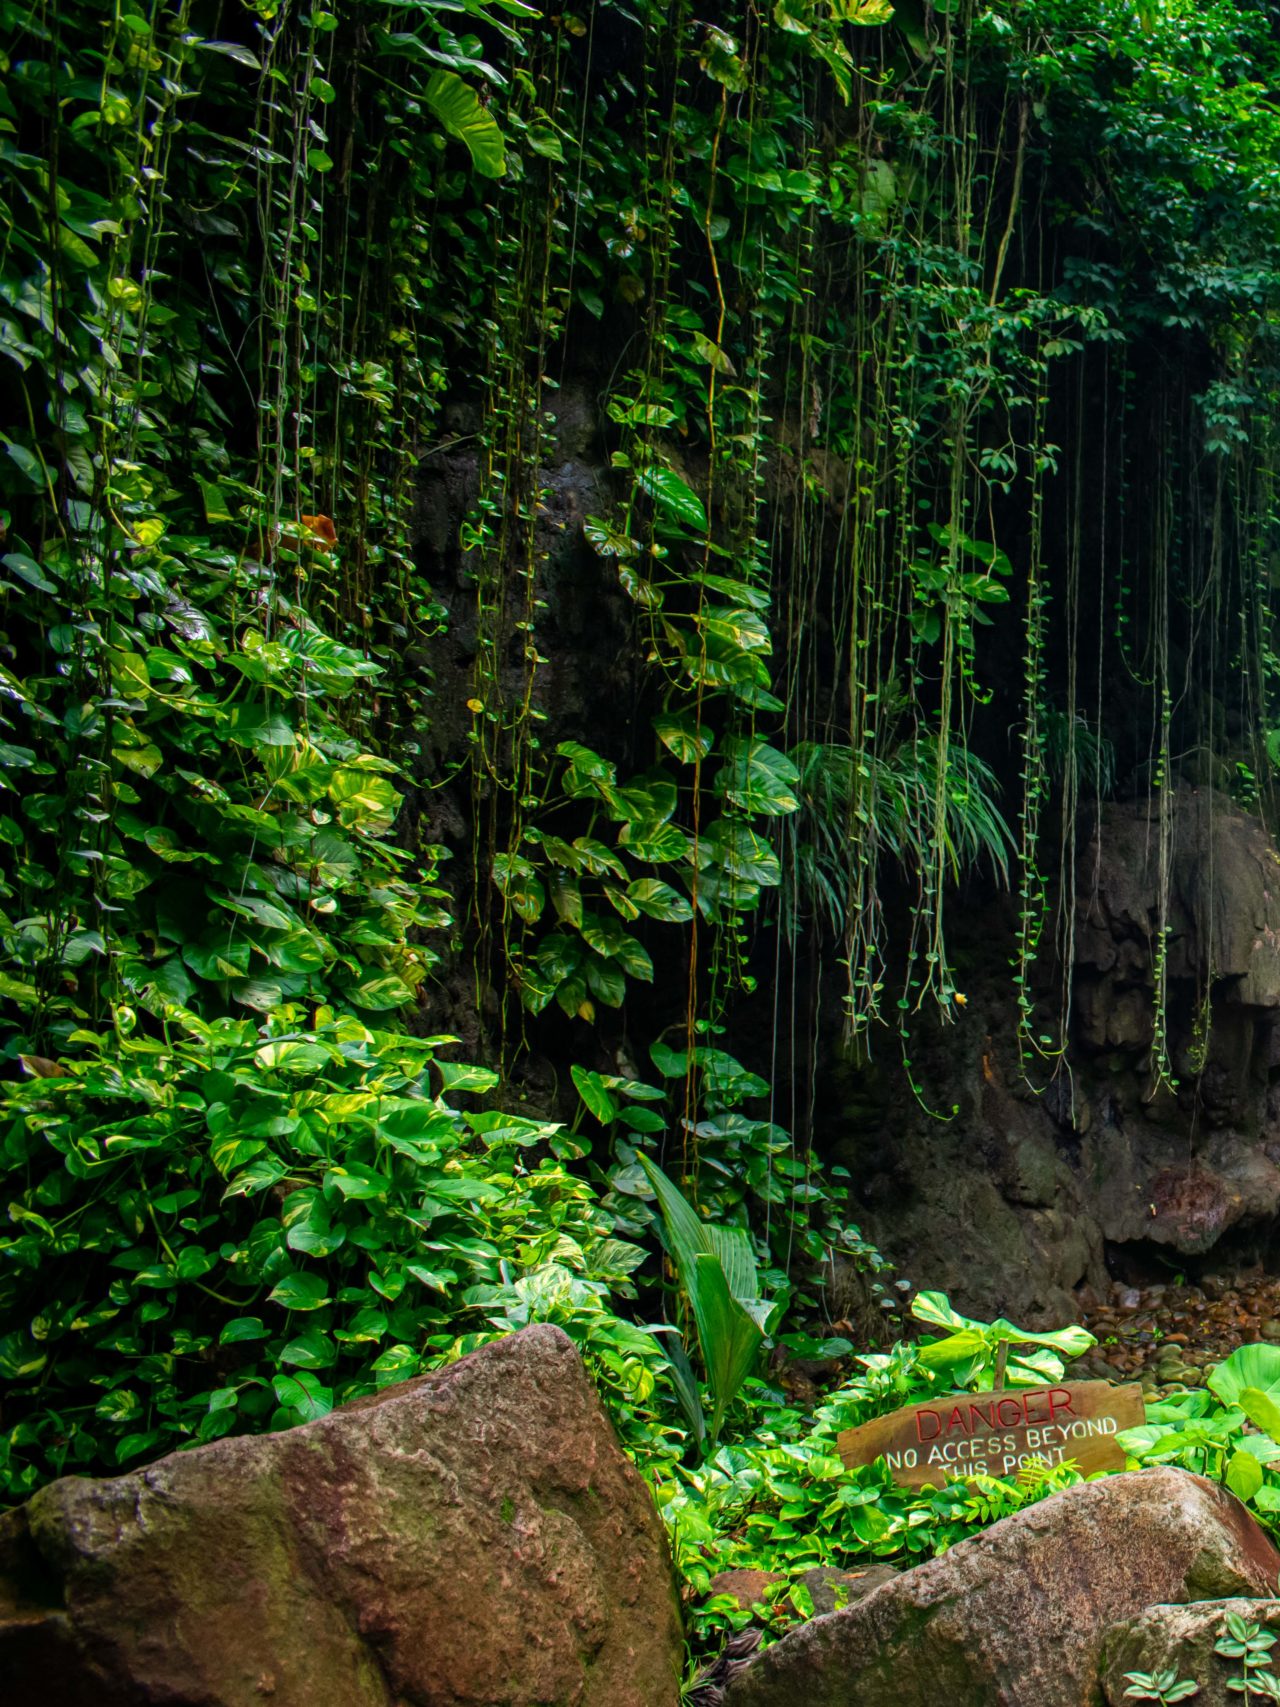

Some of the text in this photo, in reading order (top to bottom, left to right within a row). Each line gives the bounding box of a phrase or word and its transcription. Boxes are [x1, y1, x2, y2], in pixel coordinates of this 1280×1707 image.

[916, 1388, 1076, 1442] DANGER
[886, 1416, 1117, 1470] NO ACCESS BEYOND
